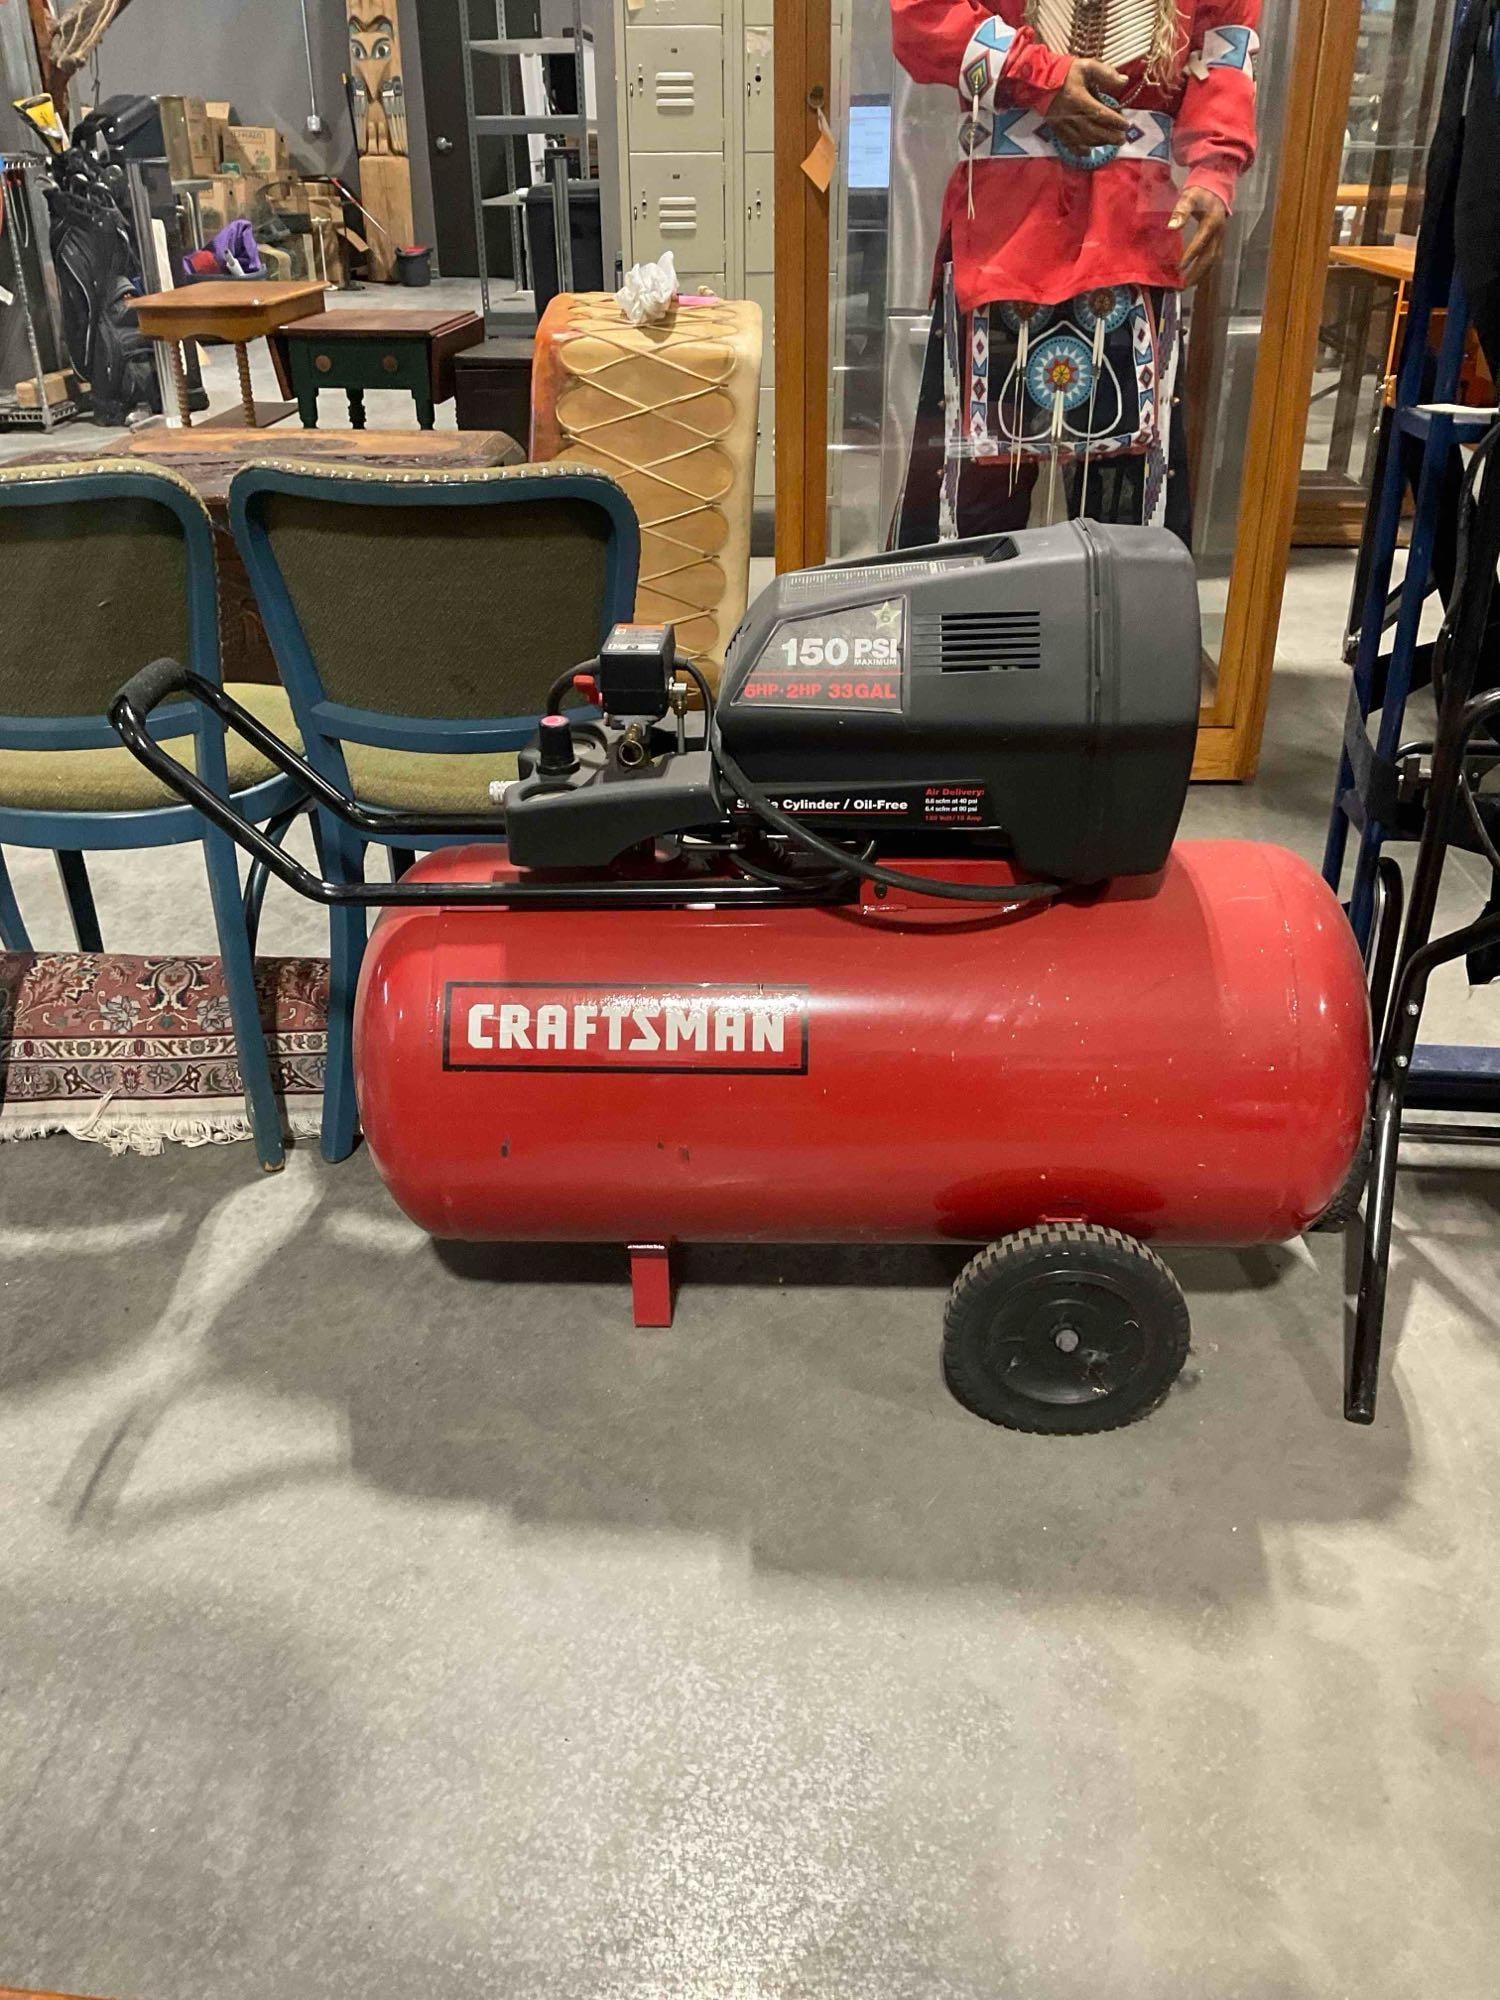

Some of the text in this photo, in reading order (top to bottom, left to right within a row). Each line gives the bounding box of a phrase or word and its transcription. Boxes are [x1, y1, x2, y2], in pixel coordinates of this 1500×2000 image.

[781, 637, 898, 666] 150 PSI
[853, 658, 897, 666] MAXIMUM
[828, 683, 896, 699] 33GAL
[925, 788, 985, 797] Air Delivery:
[783, 799, 841, 811] Cylinder
[853, 799, 908, 810] Oil-Free
[467, 1003, 786, 1053] CRAFTSMAN
